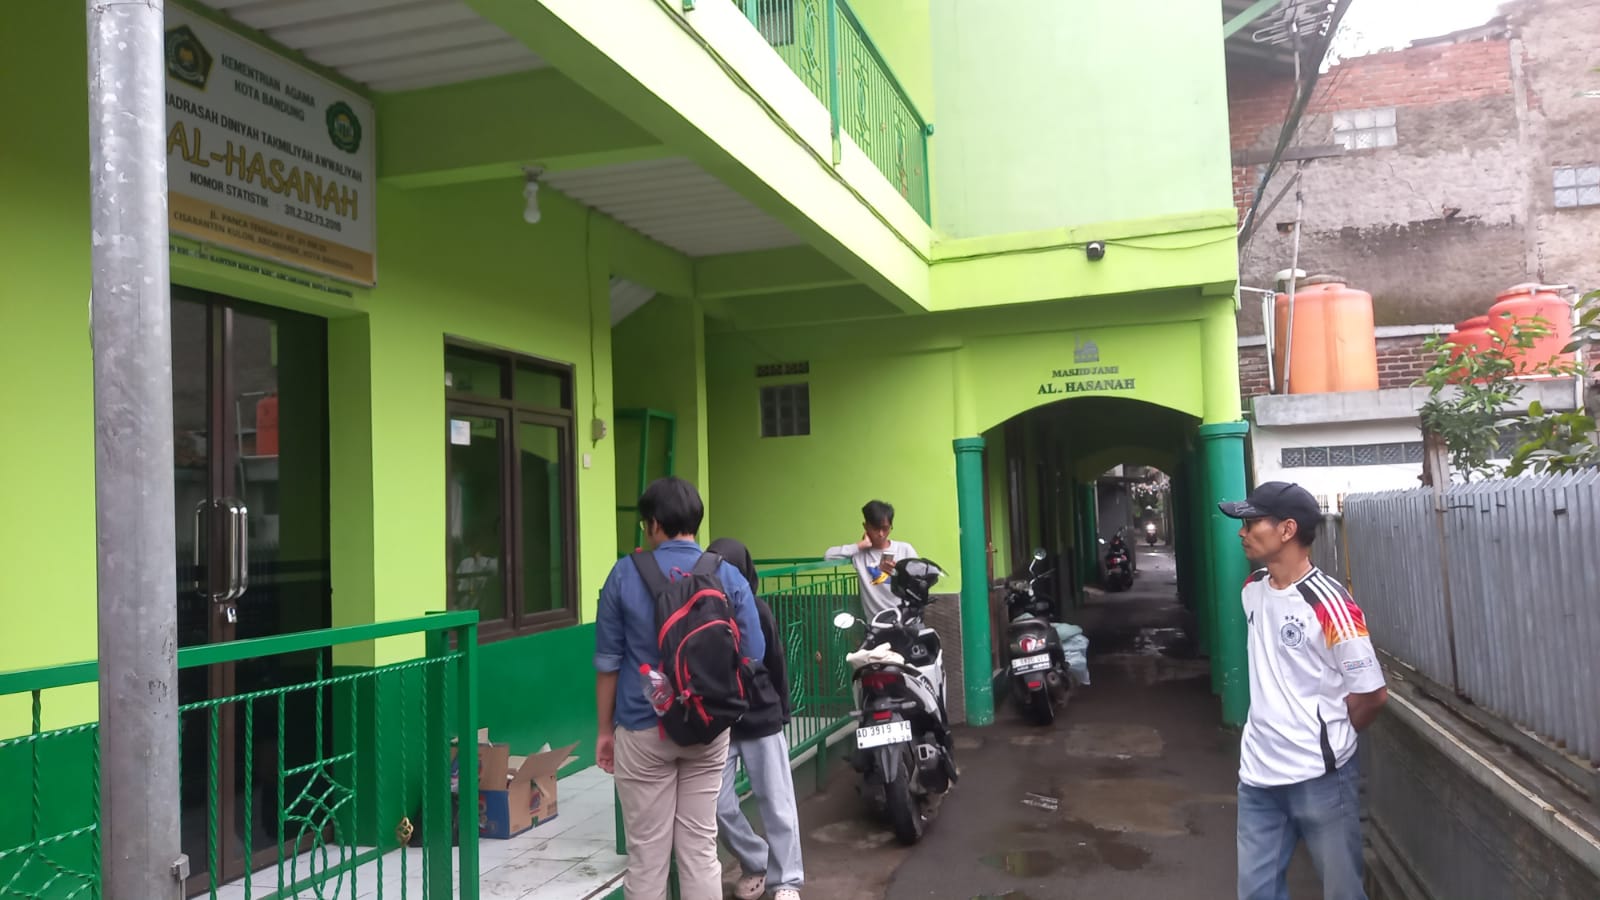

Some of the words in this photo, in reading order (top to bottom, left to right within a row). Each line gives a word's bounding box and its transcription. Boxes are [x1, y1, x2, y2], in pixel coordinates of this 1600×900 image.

[221, 53, 281, 93] KEMENTRIAN
[285, 84, 315, 108] AGAMA
[234, 79, 260, 102] KOTA
[262, 91, 304, 121] BANDUNG
[220, 114, 259, 142] DINIYAH
[261, 131, 314, 163] TAKMILIYAH
[315, 153, 362, 182] AWWALIYAH
[167, 120, 358, 221] AL-HASANAH
[190, 170, 224, 194] NOMOR
[226, 183, 269, 208] STATISTIK
[1052, 367, 1090, 378] MASJID
[1065, 378, 1135, 392] HASANAH
